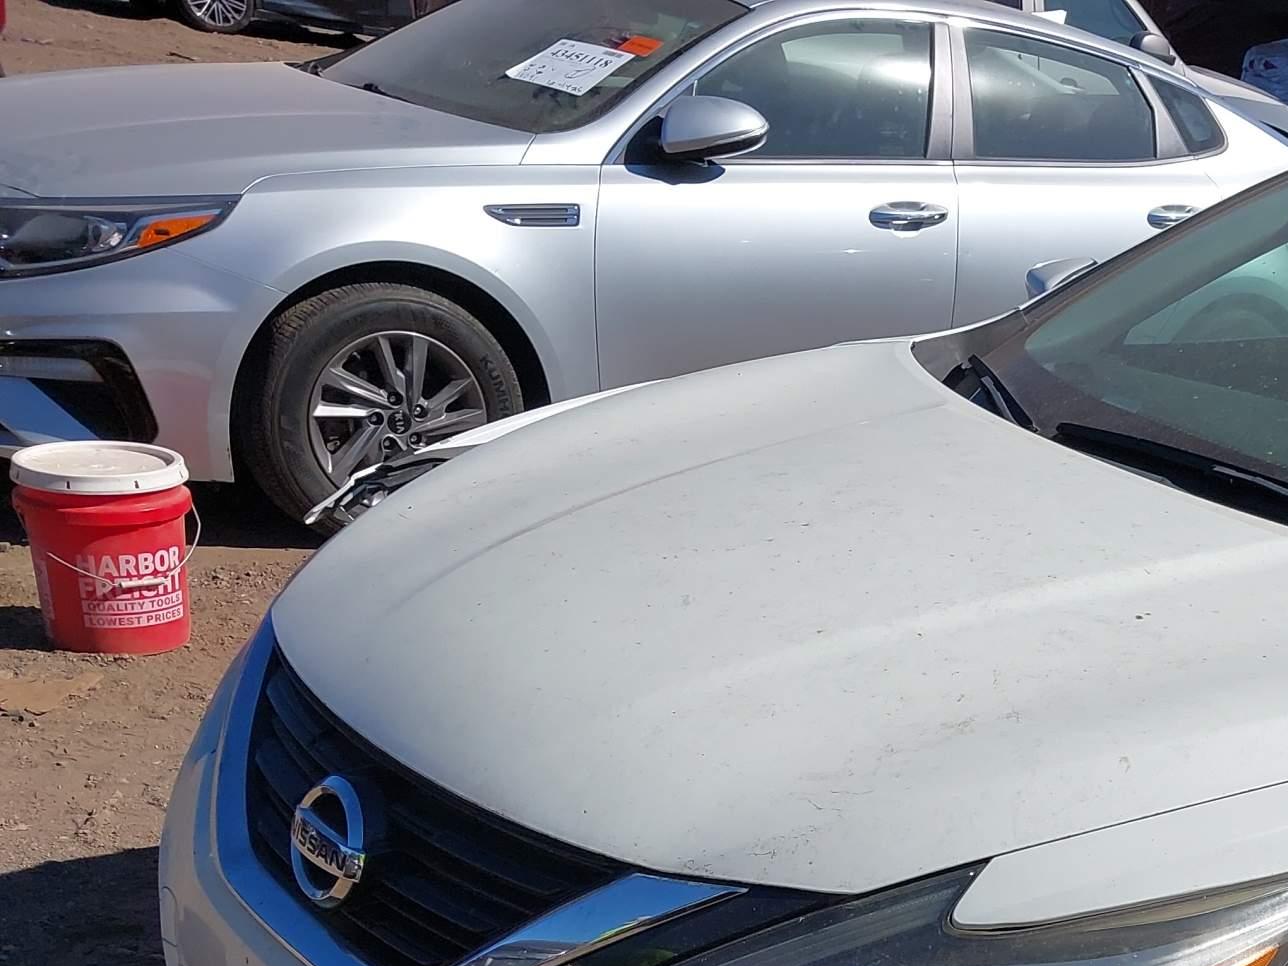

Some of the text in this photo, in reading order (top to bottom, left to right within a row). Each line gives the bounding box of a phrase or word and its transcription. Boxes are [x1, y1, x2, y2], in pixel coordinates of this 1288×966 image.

[550, 49, 613, 69] 43451118
[394, 411, 405, 434] KIA
[75, 546, 180, 577] HARBOR
[87, 593, 181, 613] QUALITY TOOLS
[88, 609, 182, 628] LOWEST PRICES
